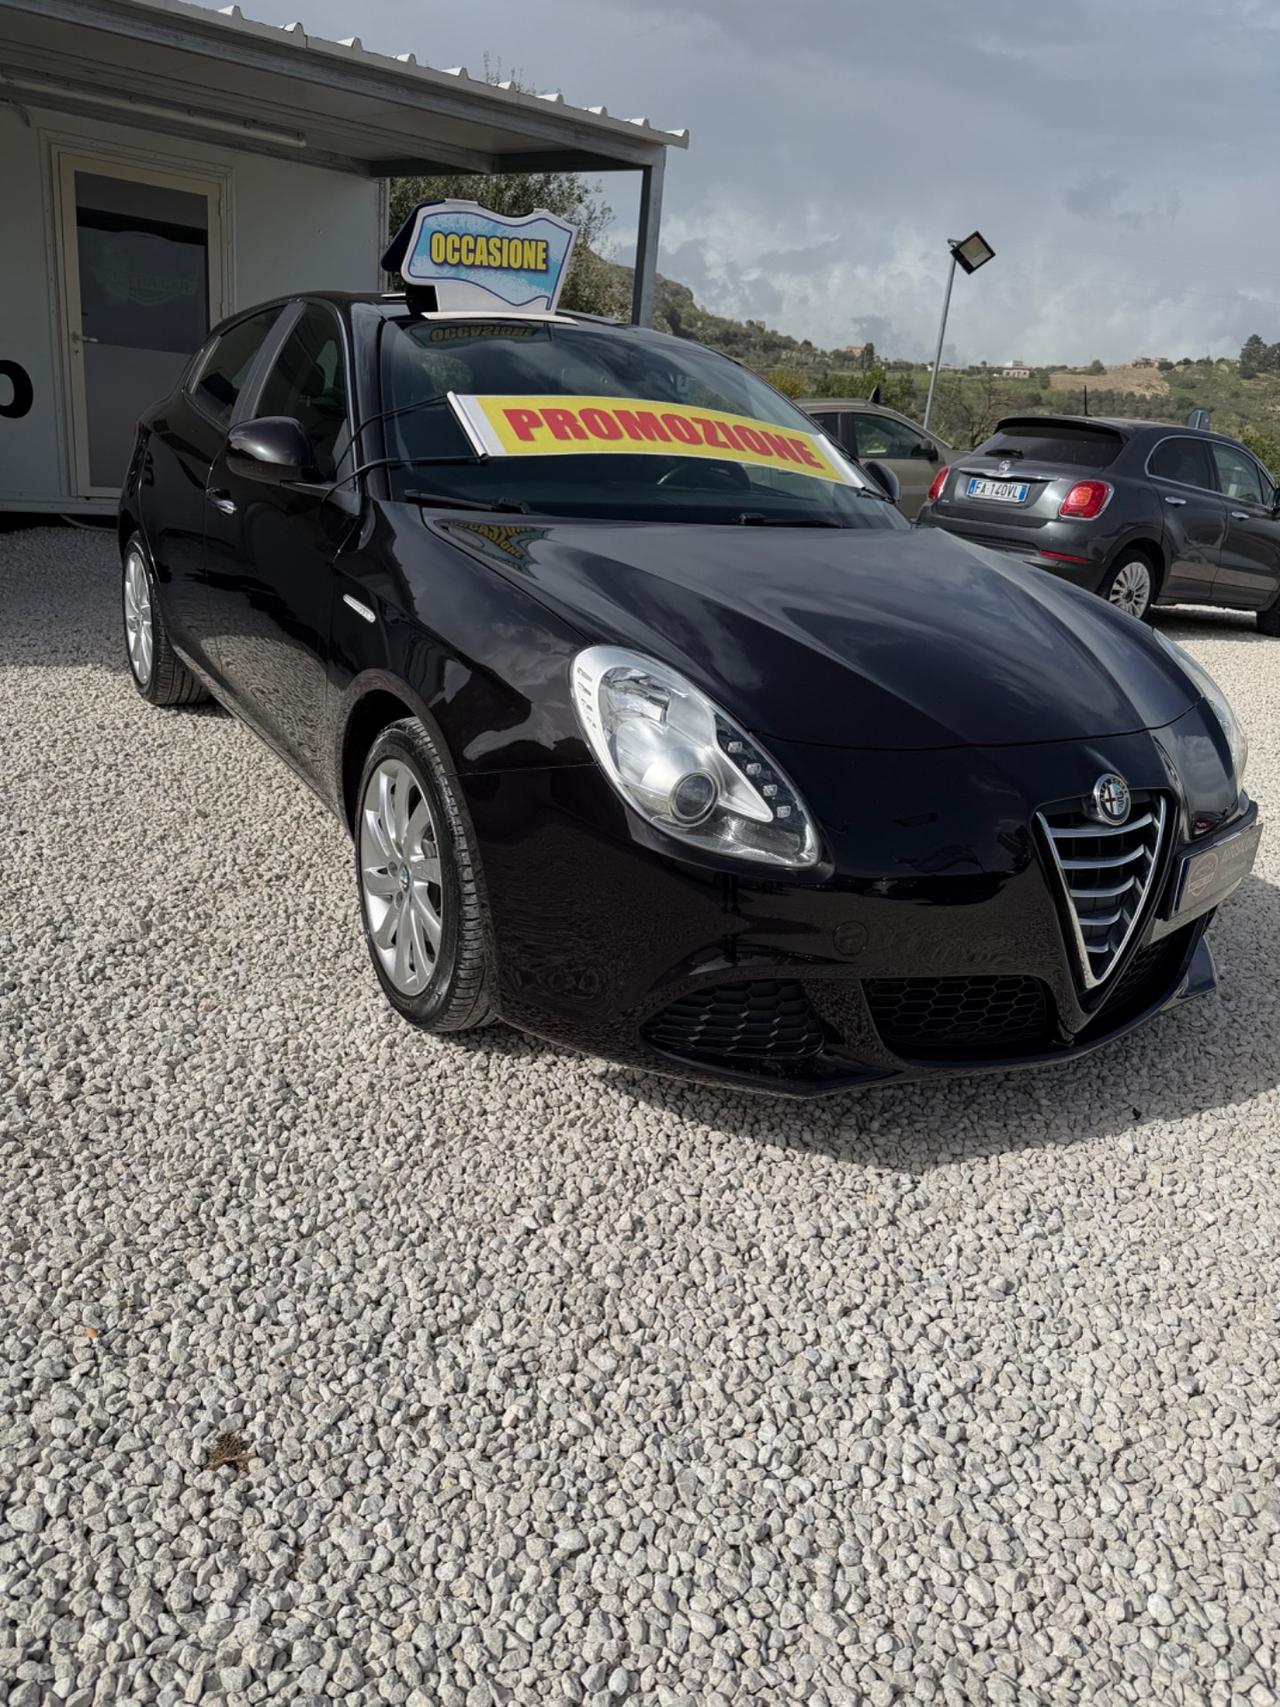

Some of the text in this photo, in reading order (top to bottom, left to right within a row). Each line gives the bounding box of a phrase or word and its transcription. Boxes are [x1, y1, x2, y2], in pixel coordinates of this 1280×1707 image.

[430, 231, 549, 271] OCCASIONE
[502, 407, 825, 470] PROMOZIONE
[975, 481, 1018, 498] FA 140VL
